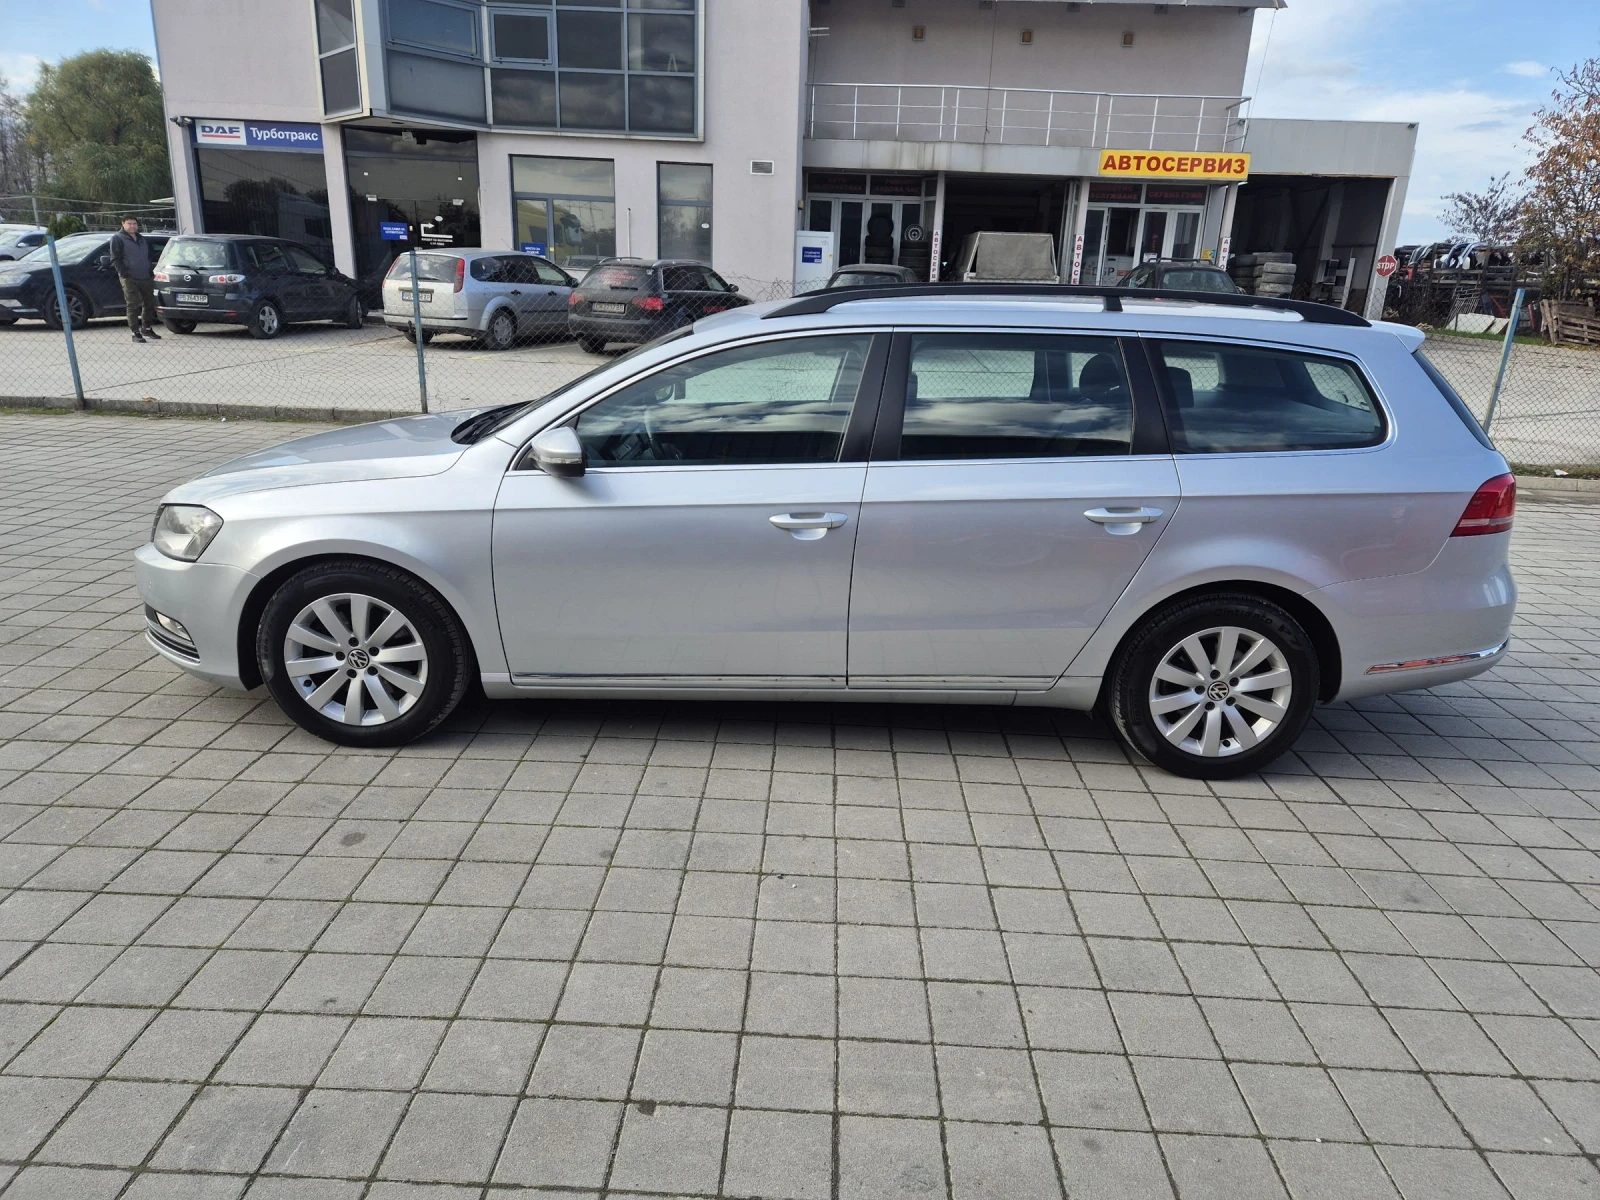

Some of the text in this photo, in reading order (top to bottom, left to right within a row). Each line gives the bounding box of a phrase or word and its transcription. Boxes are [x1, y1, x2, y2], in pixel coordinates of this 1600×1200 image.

[201, 125, 241, 135] DAF
[250, 127, 319, 142] Турботракс
[1102, 155, 1246, 175] АВТОСЕРВИЗ
[1376, 262, 1395, 270] STOP
